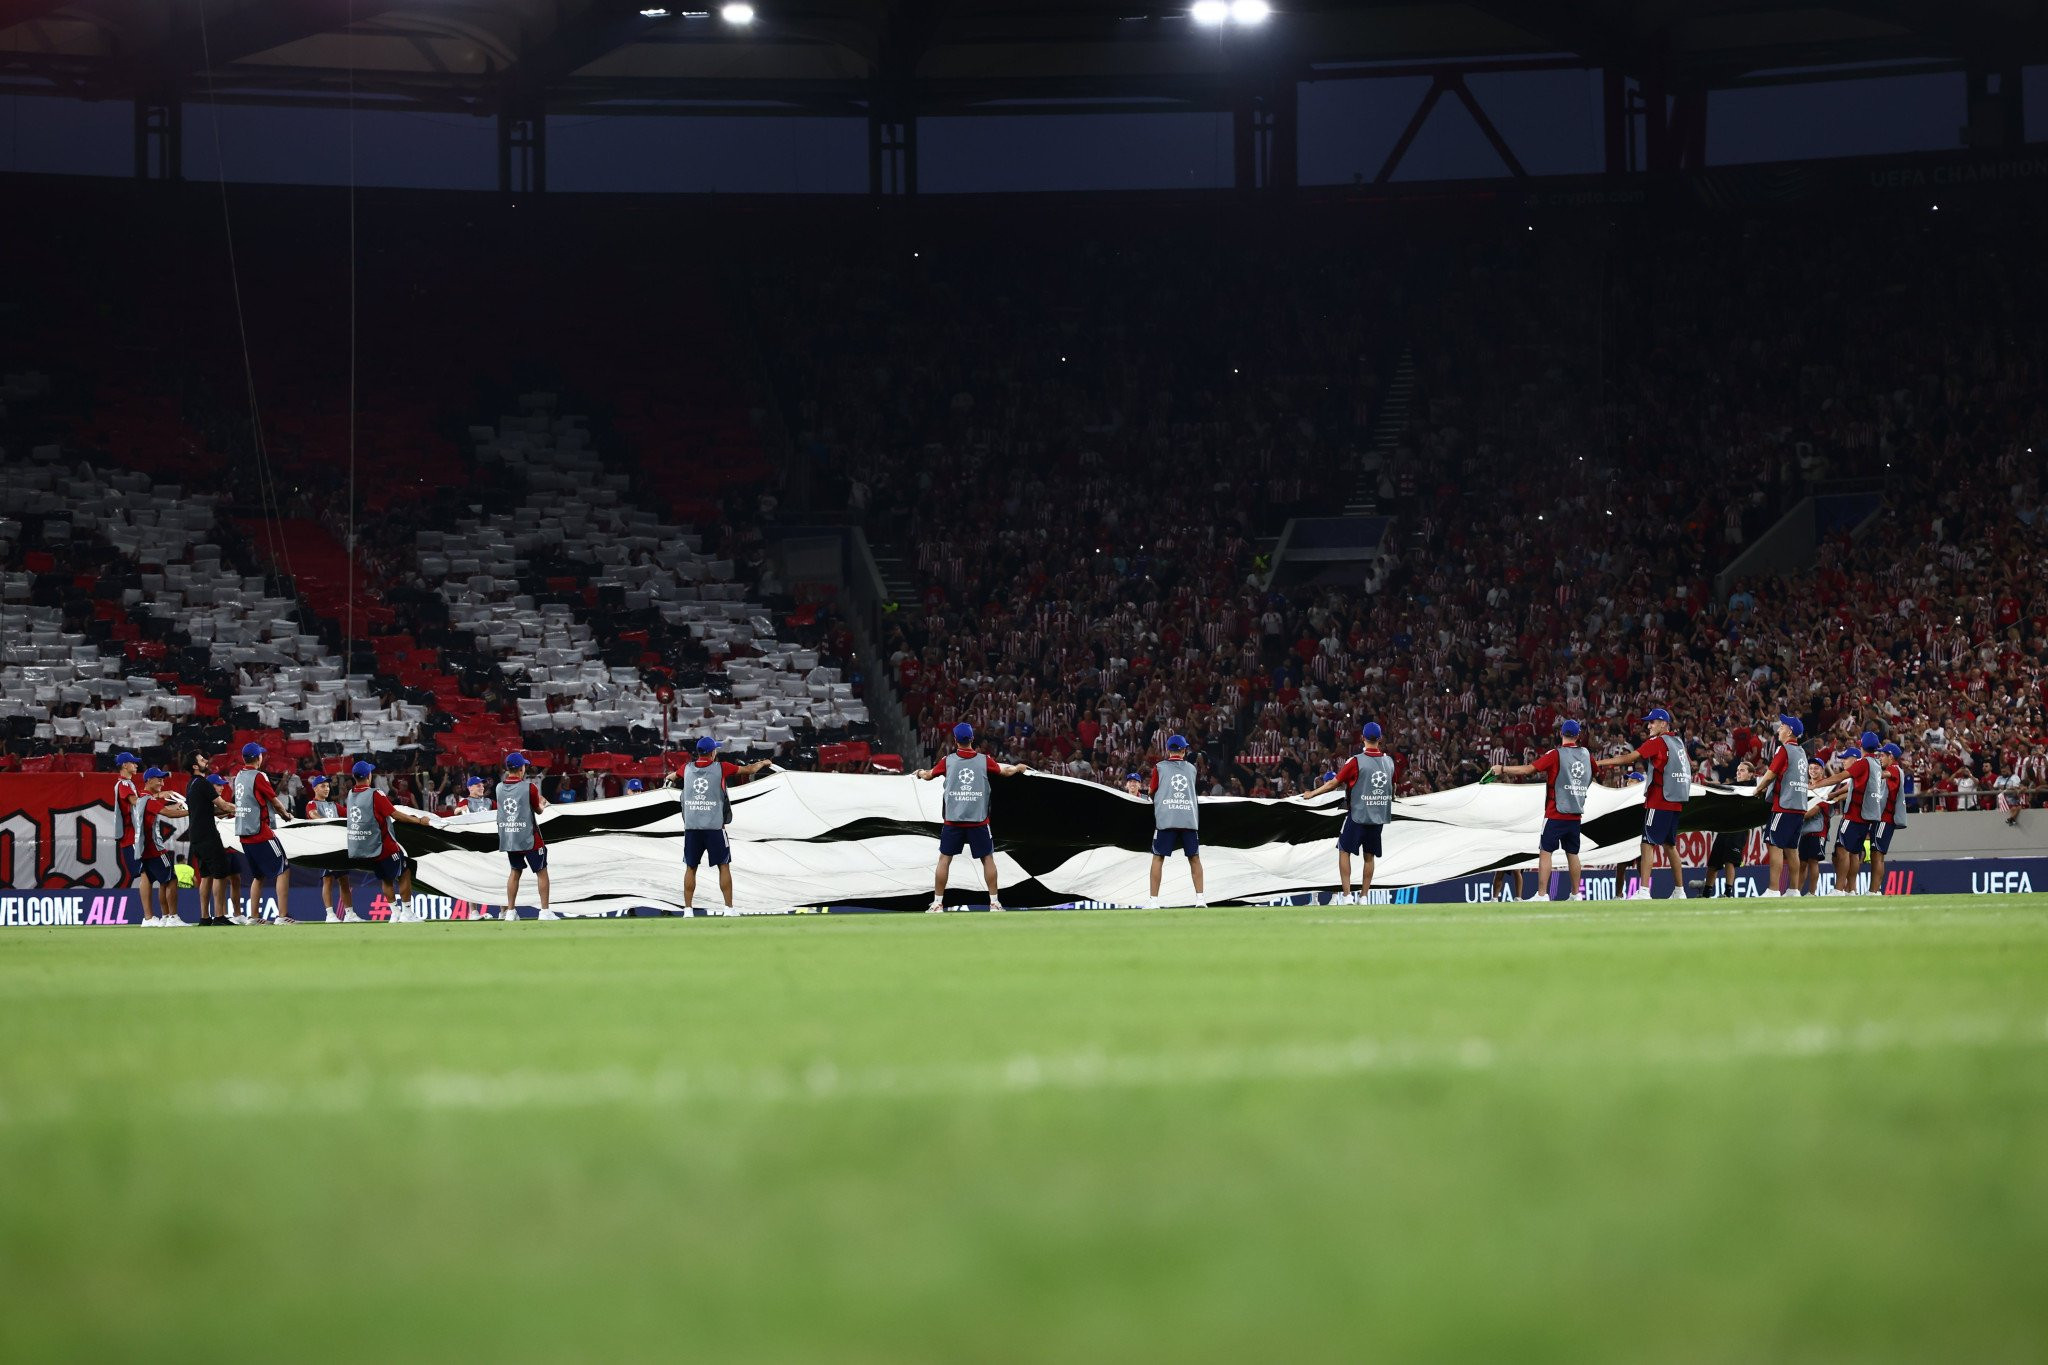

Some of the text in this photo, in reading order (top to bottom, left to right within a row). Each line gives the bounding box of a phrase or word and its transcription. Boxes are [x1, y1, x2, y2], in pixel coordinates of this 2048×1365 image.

[684, 799, 717, 807] CHAMPIONS
[1972, 871, 2033, 894] UEFA
[86, 896, 130, 925] ALL
